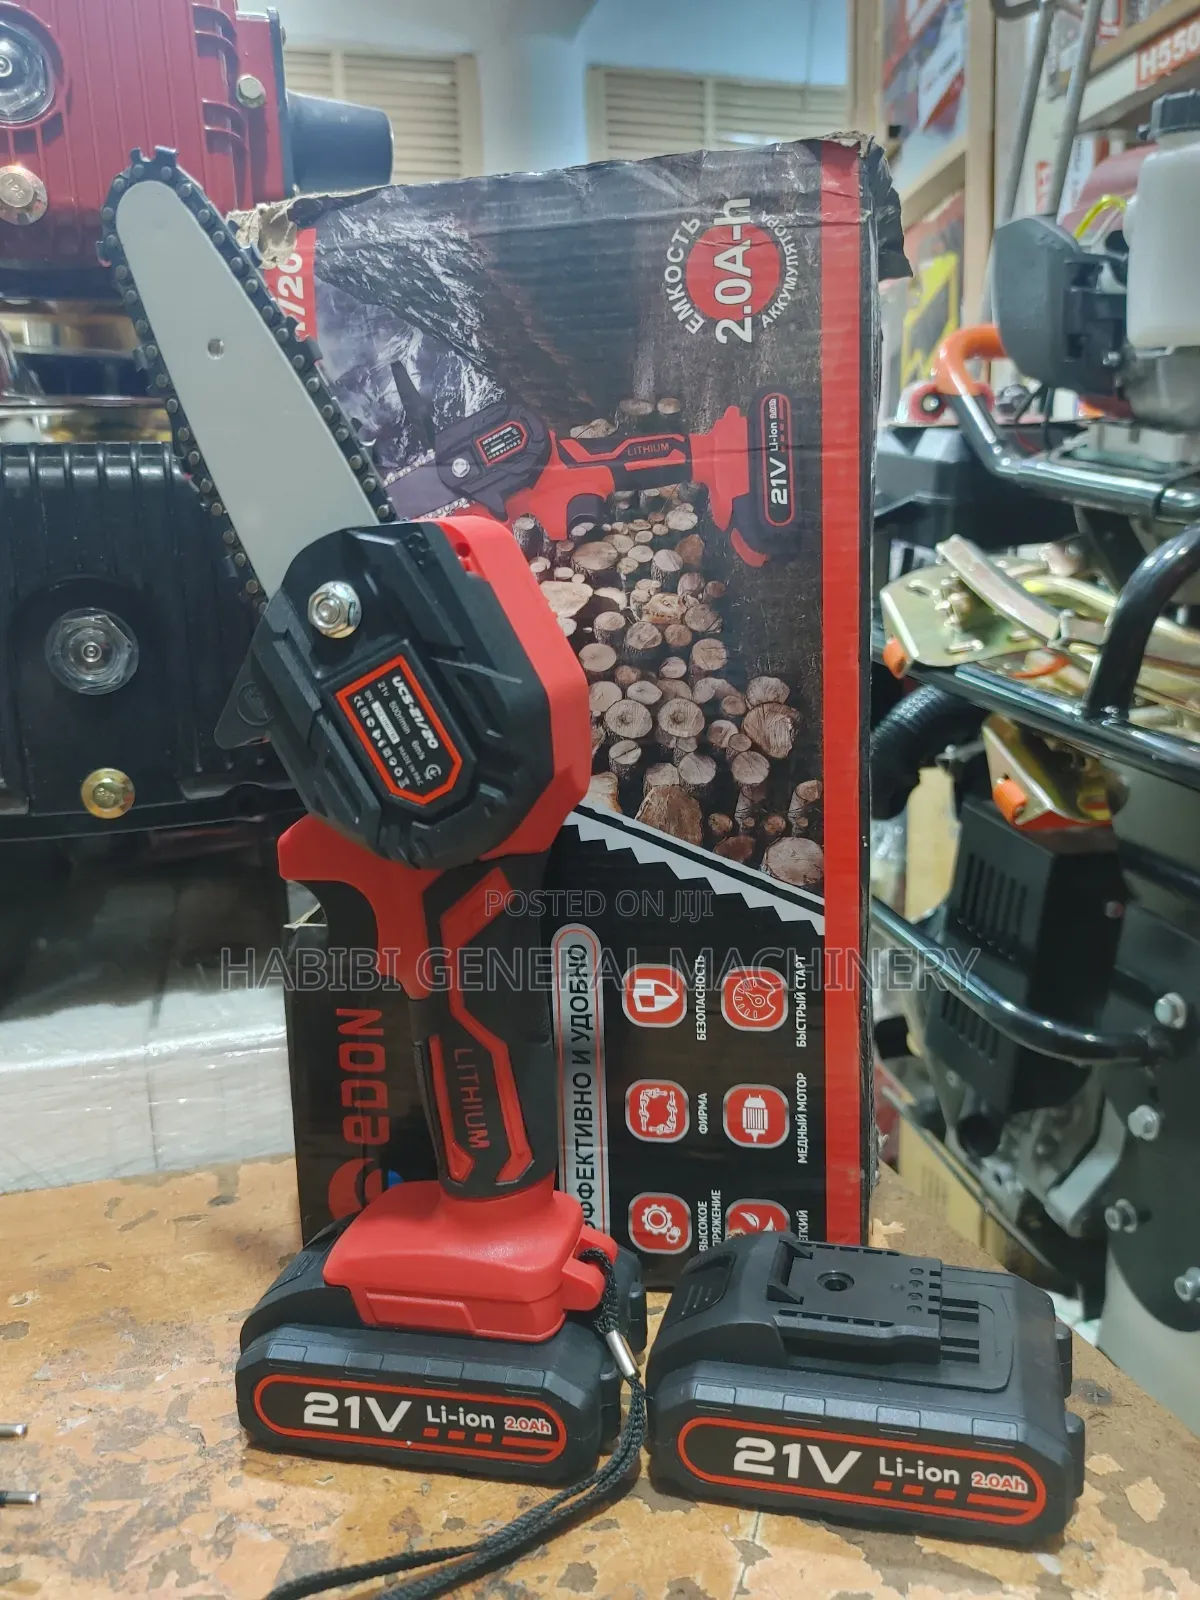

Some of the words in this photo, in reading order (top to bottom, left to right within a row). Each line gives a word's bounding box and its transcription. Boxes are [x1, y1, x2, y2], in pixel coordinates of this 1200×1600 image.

[664, 218, 705, 335] ЕМКОСТЬ
[713, 198, 752, 344] 2.0A-h
[761, 211, 798, 328] АККУМУЛЯТОРА
[627, 442, 670, 457] LITHIUM
[769, 422, 778, 452] Li-ion
[769, 457, 788, 505] 21V
[392, 676, 439, 749] UCS-21/20
[568, 944, 593, 1042] УДОБНО
[695, 955, 706, 1041] БЕЗОПАСНОСТЬ
[795, 955, 806, 990] СТАРТ
[793, 992, 807, 1047] БЫСТРЫЙ
[571, 1050, 591, 1065] И
[454, 1048, 490, 1148] LITHIUM
[698, 1093, 708, 1134] ФИРМА
[796, 1072, 808, 1112] МОТОР
[795, 1113, 809, 1164] МЕДНЫЙ
[303, 1391, 412, 1433] 21V
[426, 1404, 496, 1430] Li-ion
[503, 1415, 553, 1437] 2.0Ah
[733, 1437, 862, 1484] 21V
[878, 1456, 961, 1485] Li-ion
[971, 1470, 1029, 1495] 2.0Ah
